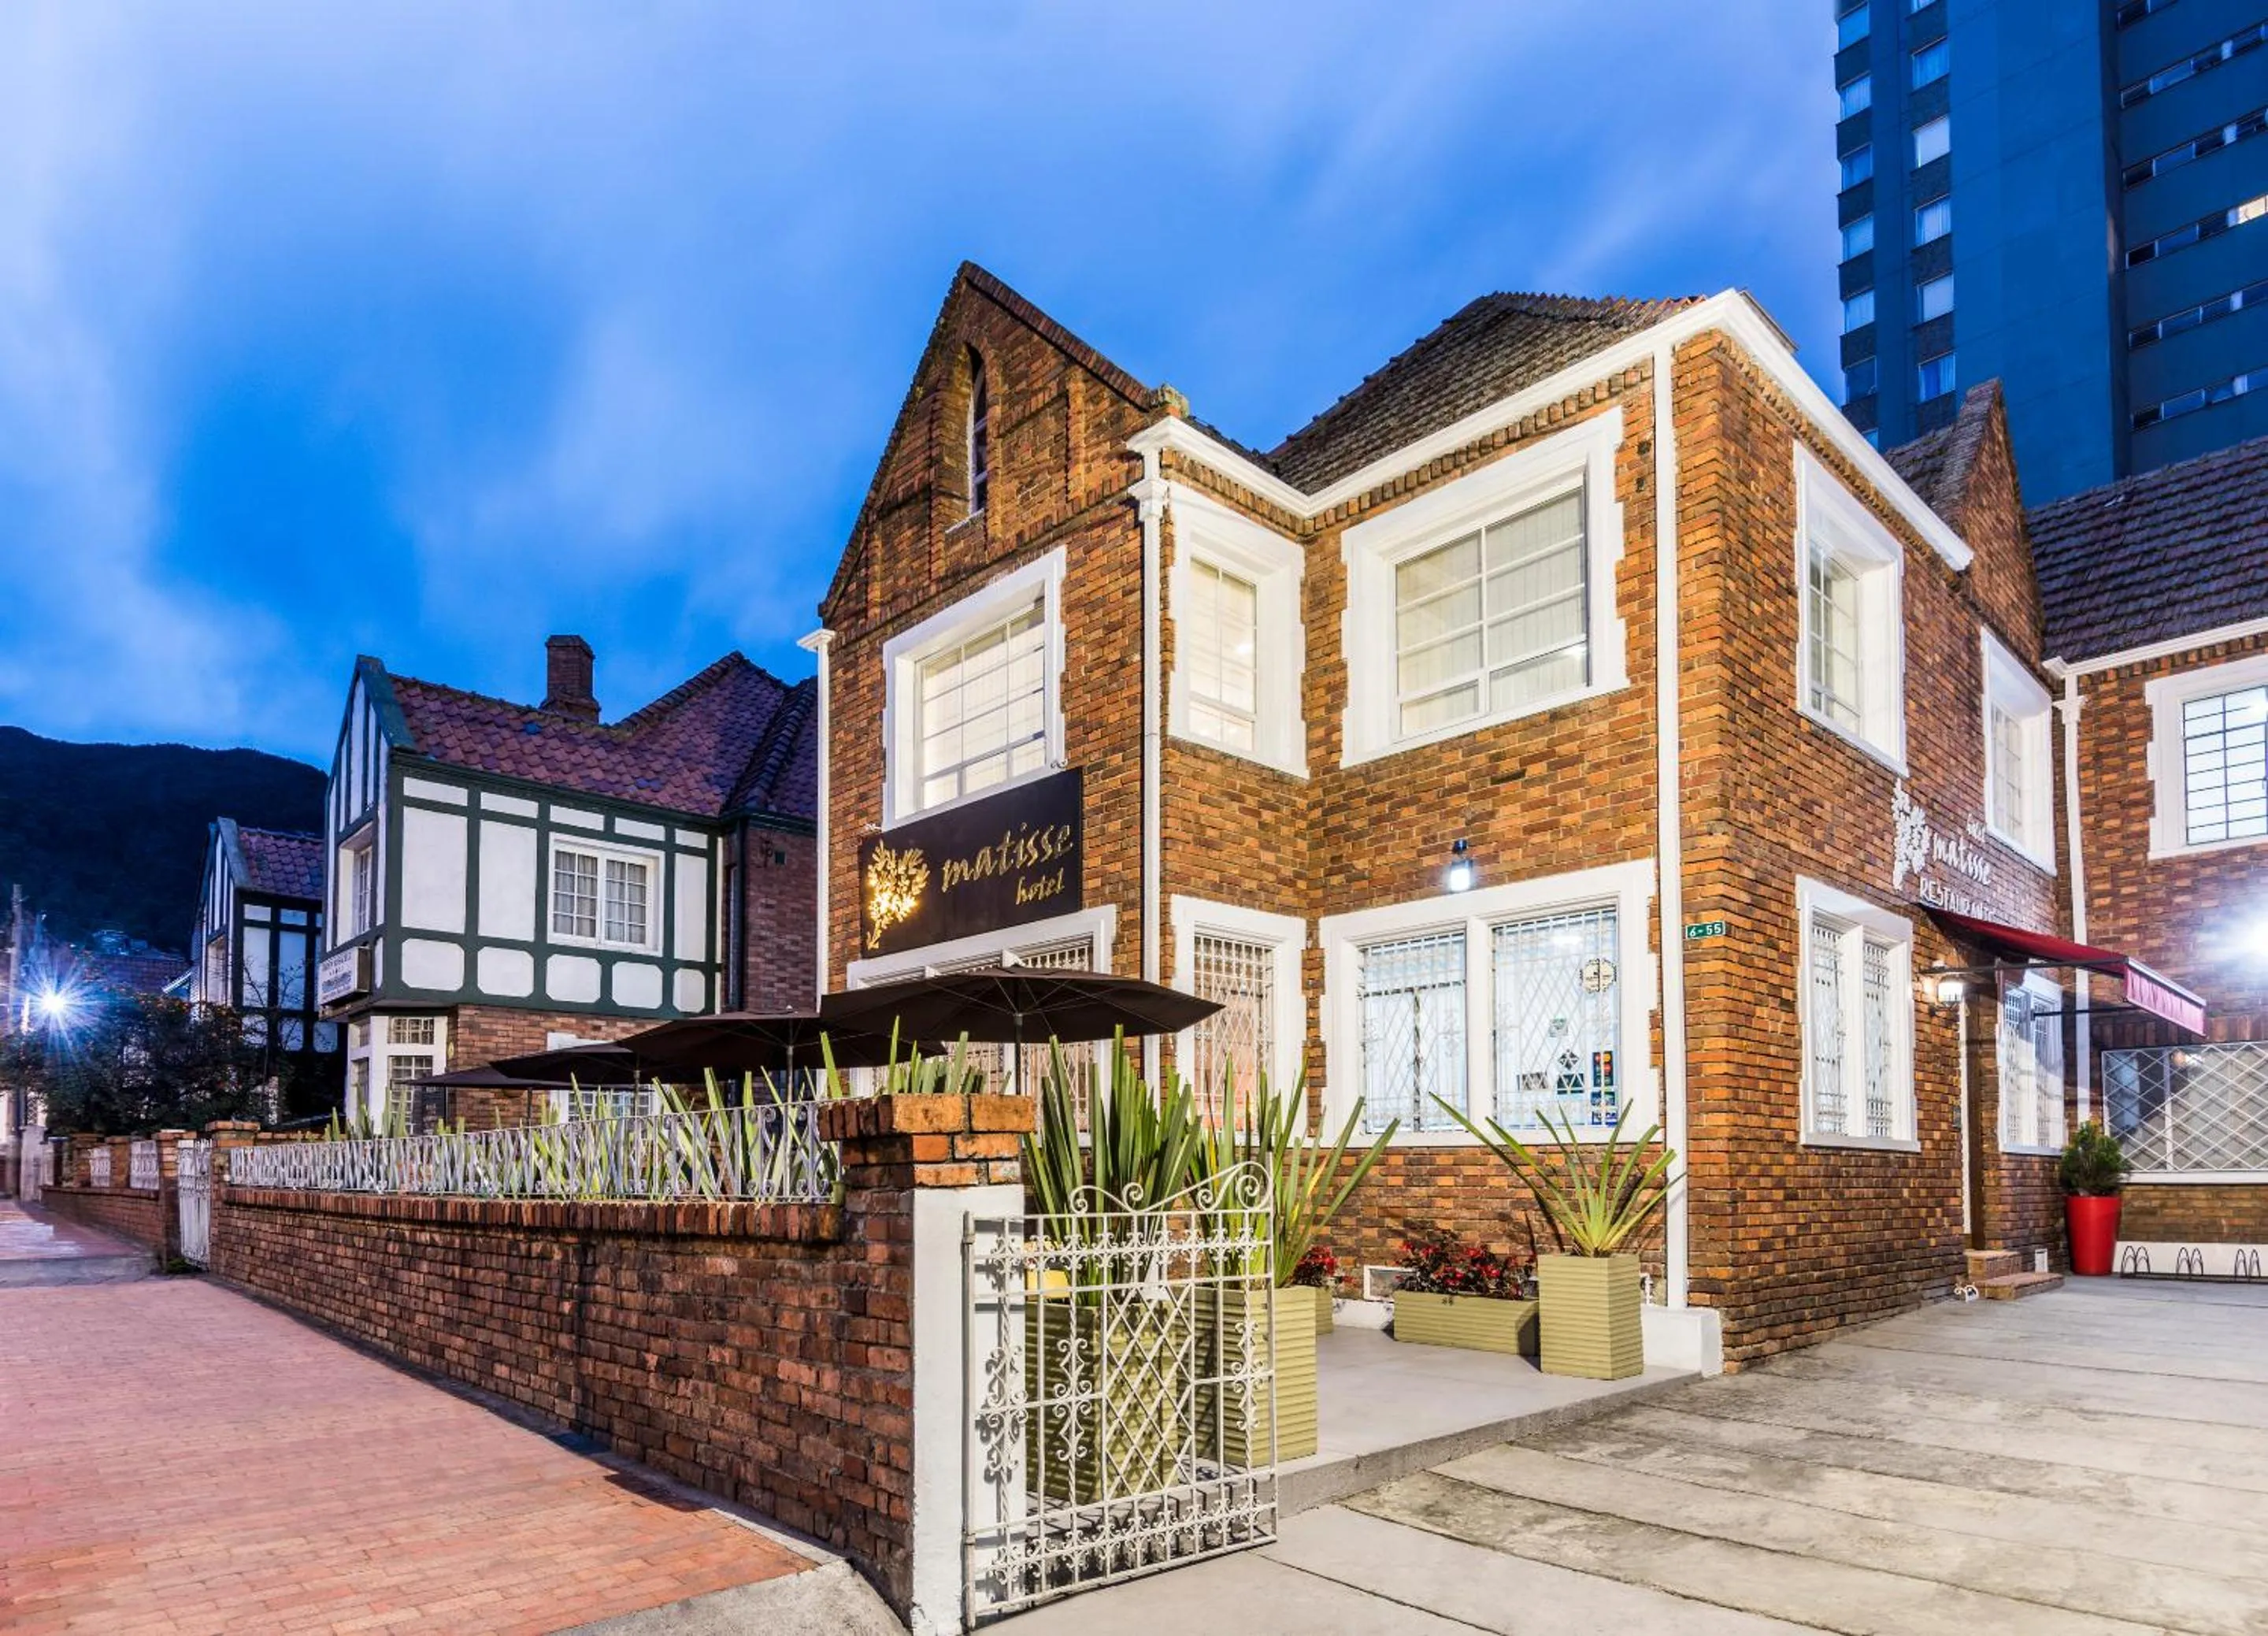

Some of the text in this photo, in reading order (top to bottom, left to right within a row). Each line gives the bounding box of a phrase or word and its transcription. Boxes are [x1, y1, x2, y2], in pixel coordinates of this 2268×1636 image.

[941, 822, 1073, 892] matisse
[1932, 832, 1992, 885] matisse
[1016, 867, 1065, 905] hotel
[1689, 923, 1721, 937] 6-55
